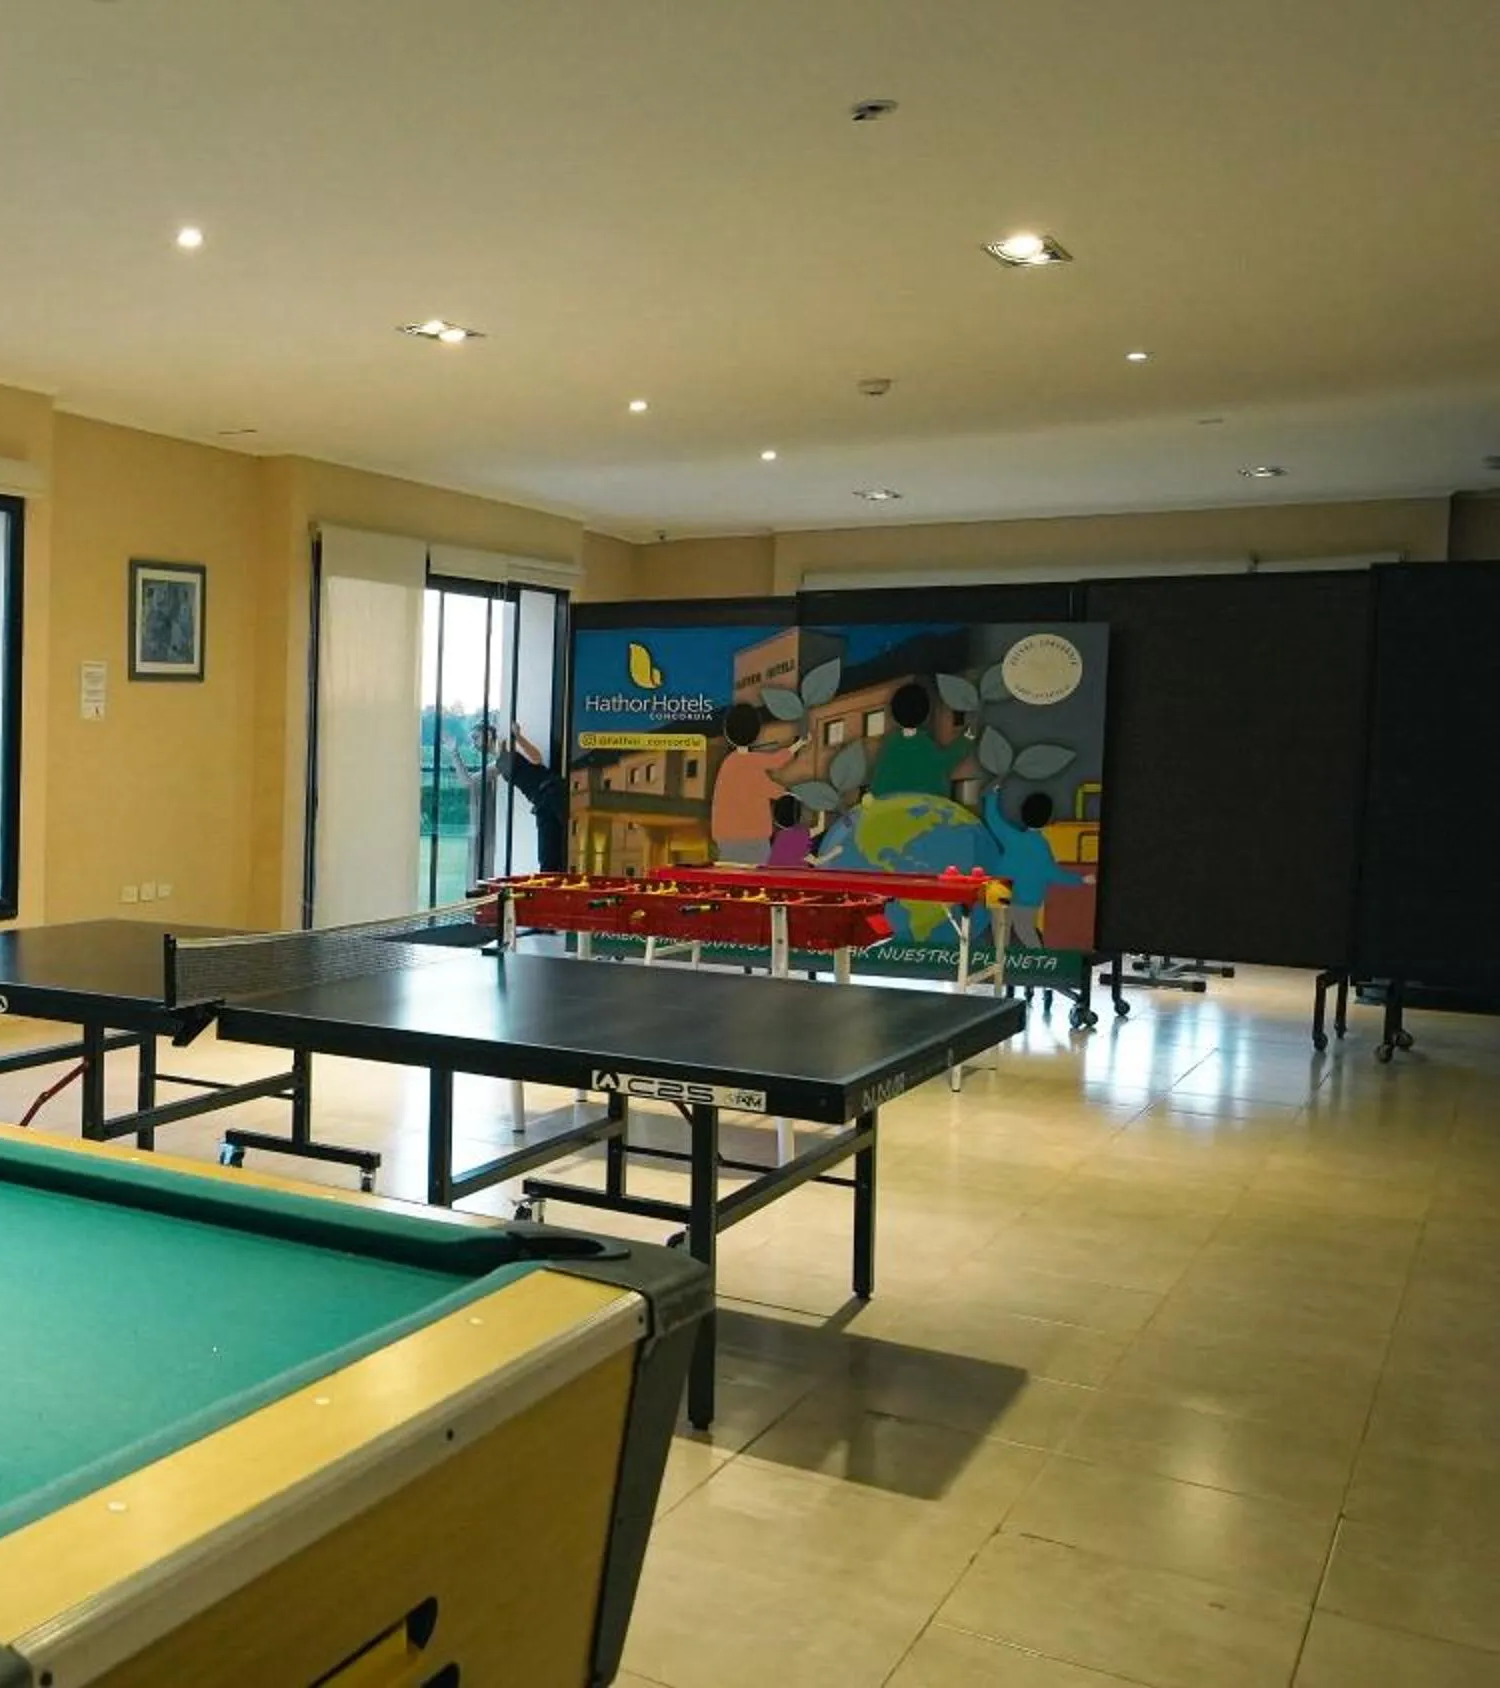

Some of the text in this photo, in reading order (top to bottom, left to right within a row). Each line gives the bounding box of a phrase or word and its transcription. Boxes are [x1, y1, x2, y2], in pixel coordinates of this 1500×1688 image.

[877, 948, 961, 965] NUESTRO
[971, 951, 1058, 970] PLNETA
[628, 1078, 714, 1103] C25
